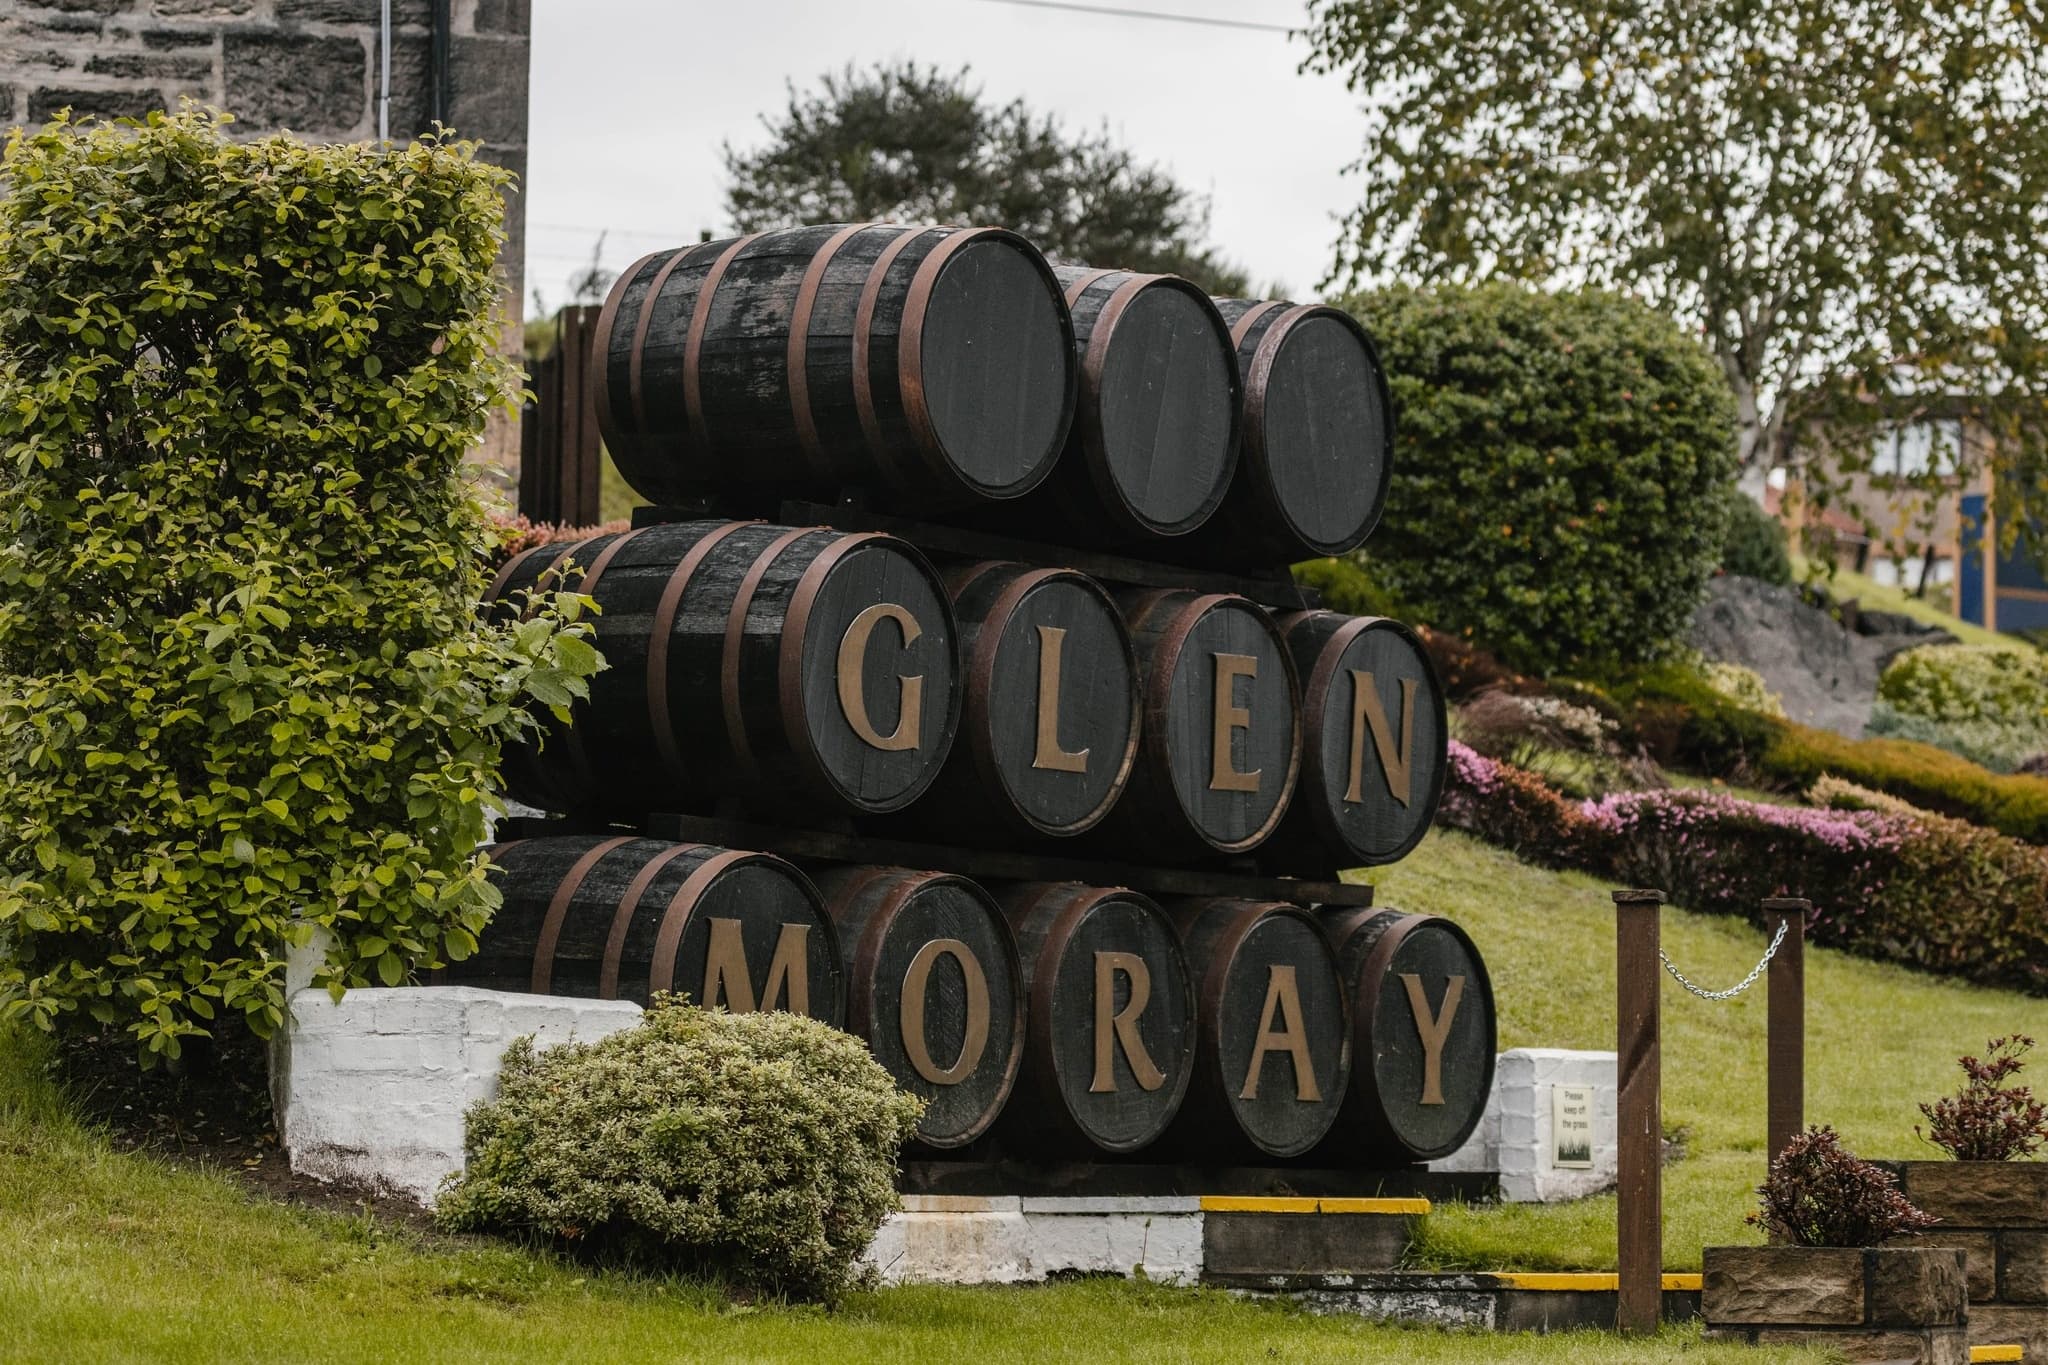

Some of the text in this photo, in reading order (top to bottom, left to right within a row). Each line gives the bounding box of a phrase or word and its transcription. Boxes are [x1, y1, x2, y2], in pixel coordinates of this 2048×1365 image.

[837, 602, 1419, 809] GLEN
[702, 917, 1466, 1106] MORAY
[1562, 1120, 1571, 1128] the
[1564, 1106, 1577, 1115] keep
